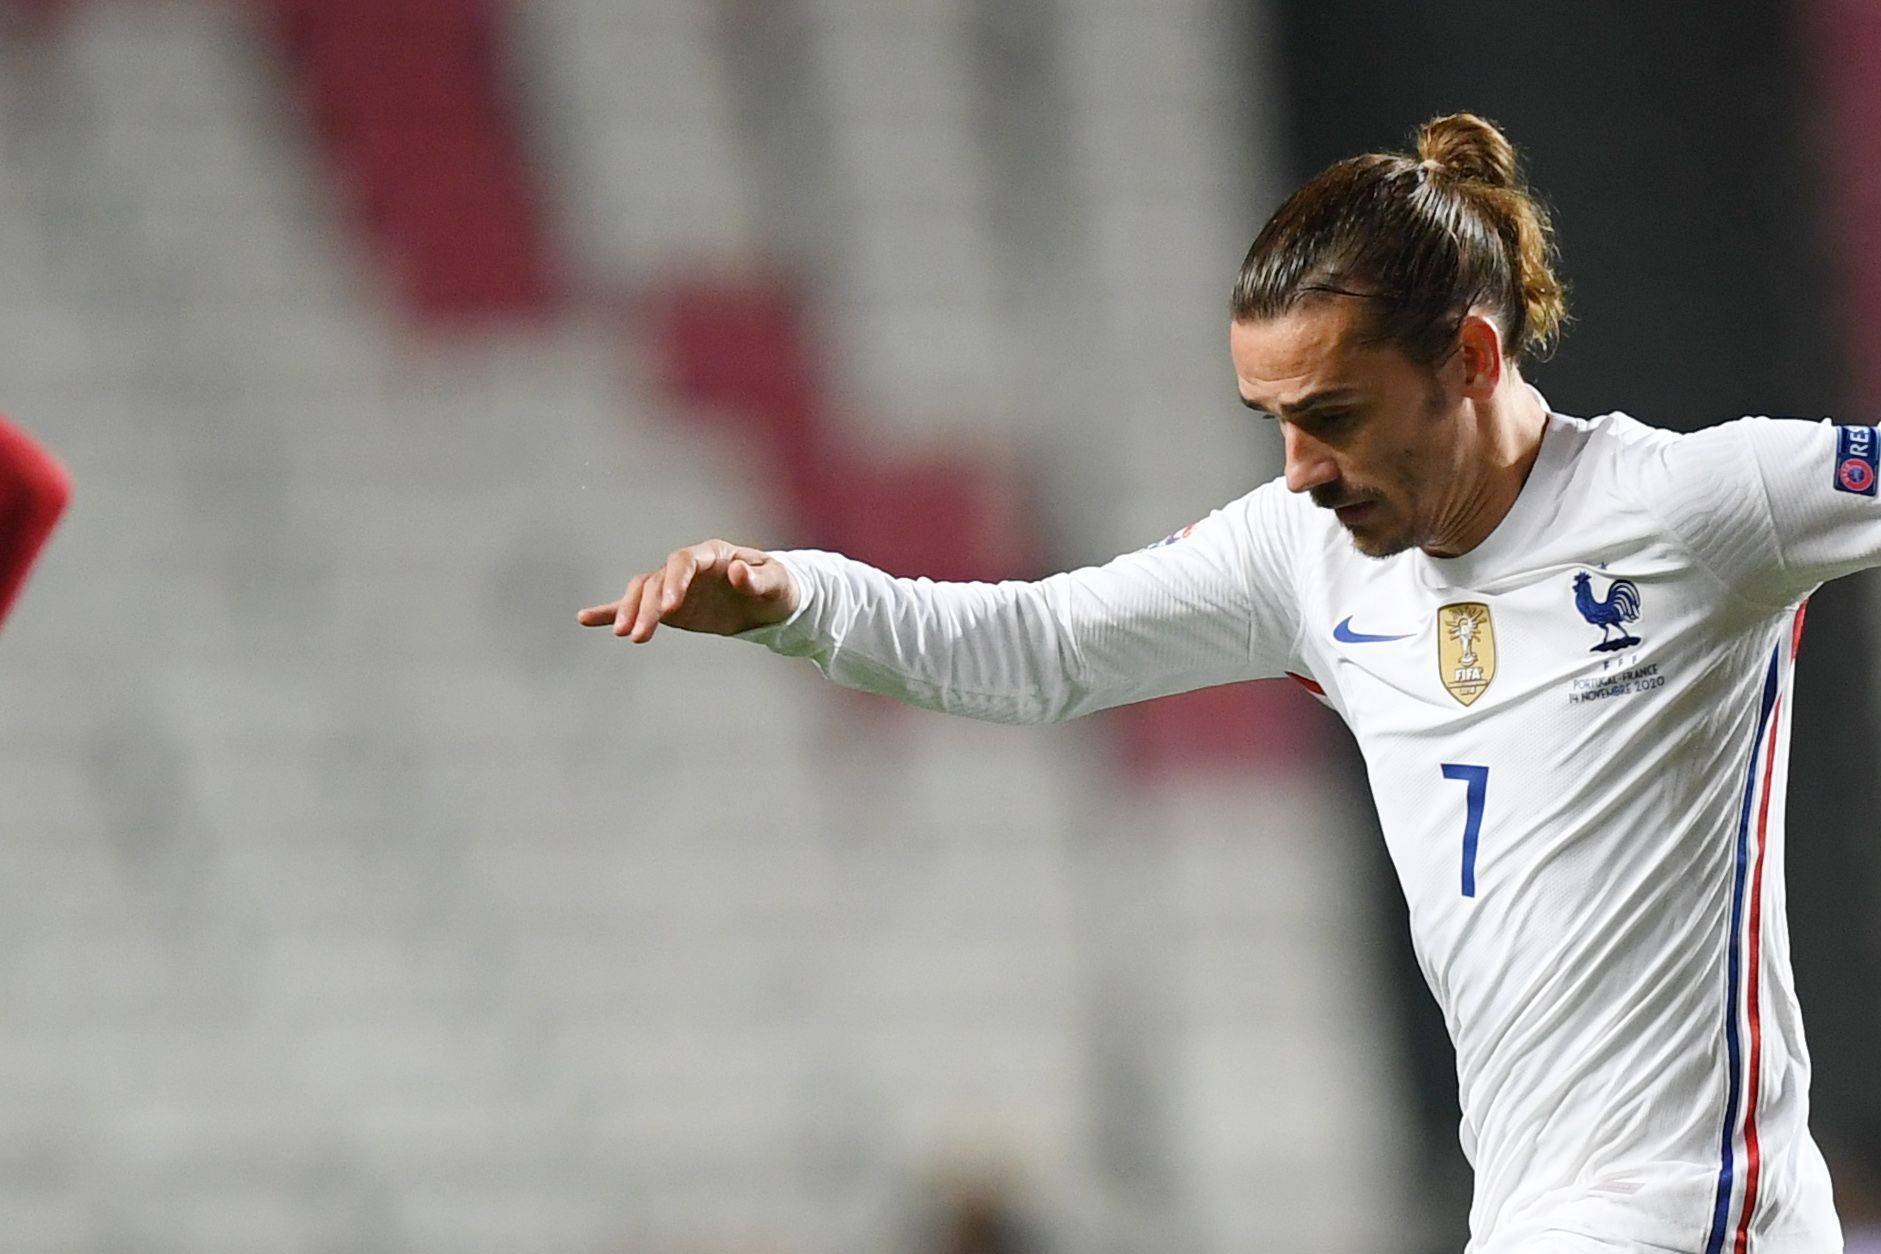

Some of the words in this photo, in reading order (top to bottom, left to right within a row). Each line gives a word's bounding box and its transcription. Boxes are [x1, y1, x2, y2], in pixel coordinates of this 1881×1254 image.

[1455, 667, 1482, 681] FIFA
[1581, 684, 1633, 703] NOVEMBRE
[1635, 675, 1665, 692] 2020
[1441, 763, 1490, 899] 7
